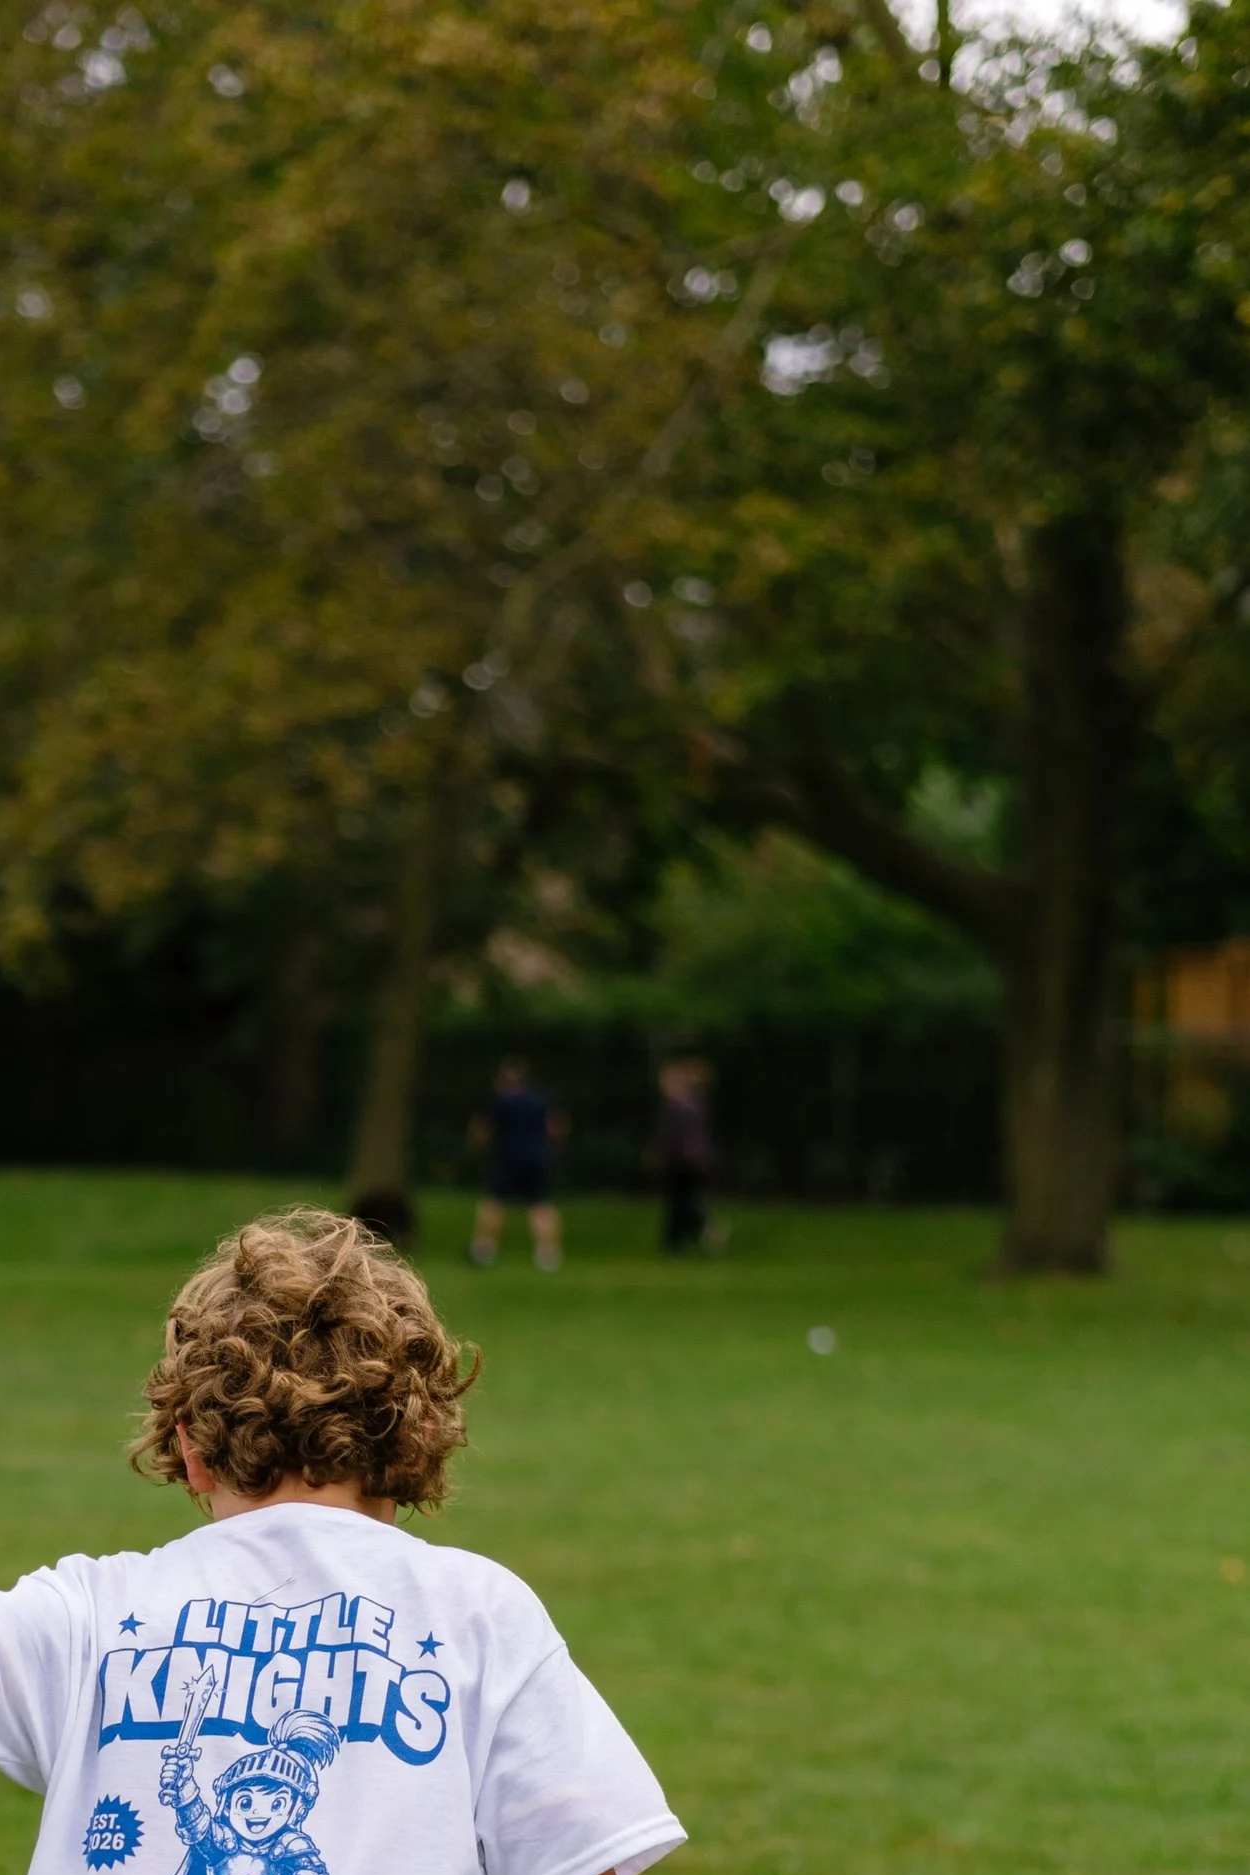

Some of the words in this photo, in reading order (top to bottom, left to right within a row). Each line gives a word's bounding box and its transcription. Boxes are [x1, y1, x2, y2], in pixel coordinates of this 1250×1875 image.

[174, 1592, 395, 1651] LITTLE
[99, 1643, 450, 1765] KNIGHTS
[92, 1813, 121, 1831] EST.
[88, 1832, 126, 1852] 026
